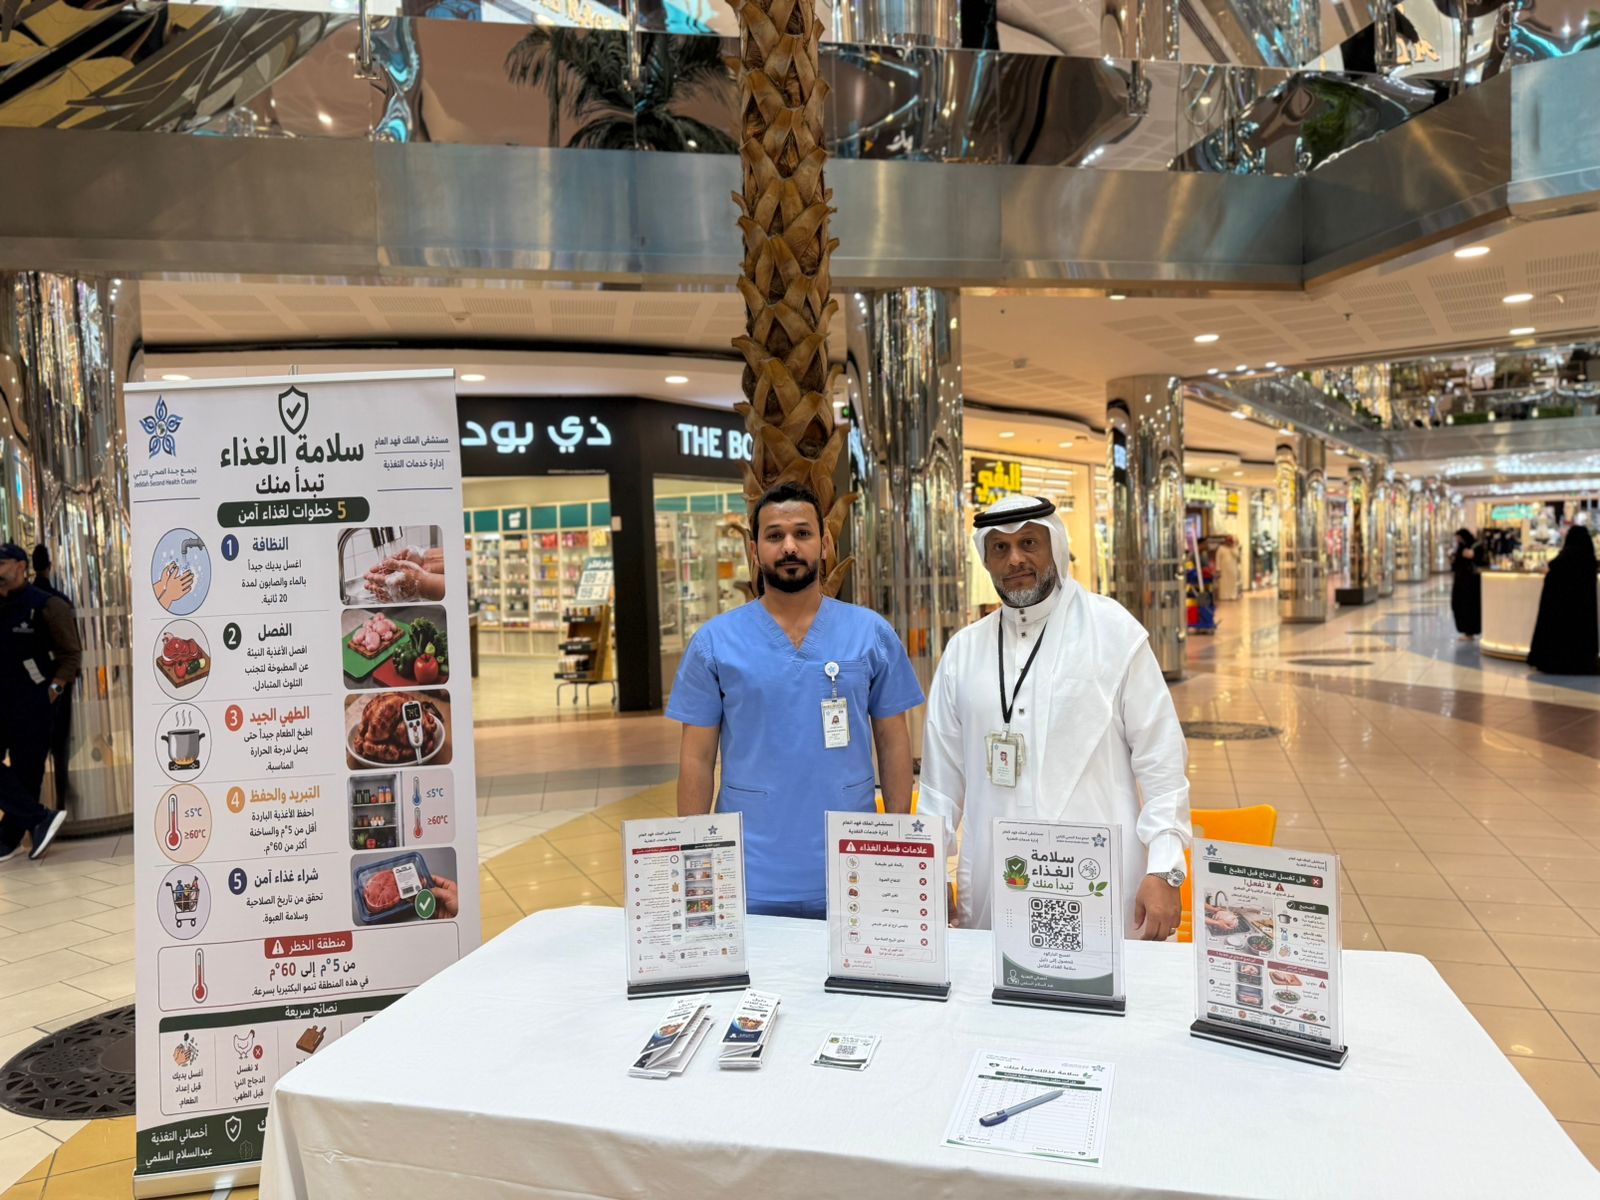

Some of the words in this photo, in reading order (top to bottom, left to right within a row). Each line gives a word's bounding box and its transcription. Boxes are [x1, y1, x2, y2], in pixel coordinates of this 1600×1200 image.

[389, 435, 401, 447] فهد
[402, 435, 420, 445] الملك
[420, 435, 449, 447] مستشفى
[547, 416, 612, 454] ذي
[677, 422, 723, 459] THE
[295, 432, 364, 463] سلامة
[374, 436, 389, 449] العام
[220, 435, 287, 468] الغذاء
[383, 459, 405, 472] التغذية
[406, 459, 428, 469] خدمات
[429, 459, 445, 471] إدارة
[256, 474, 291, 495] منك
[294, 466, 324, 499] تبدأ
[238, 503, 259, 525] آمن
[262, 504, 289, 520] لغذاء
[292, 503, 333, 522] خطوات
[337, 501, 347, 520] 5
[227, 539, 233, 558] 1
[252, 536, 289, 552] النظافة
[265, 561, 282, 572] يديك
[241, 578, 258, 588] لمدة
[259, 577, 288, 590] والصابون
[289, 576, 307, 588] بالماء
[279, 593, 288, 603] 20
[228, 627, 238, 646] 2
[258, 622, 292, 642] الفصل
[267, 645, 288, 659] الأغذية
[244, 664, 266, 677] لتجنب
[267, 662, 298, 674] المطبوخة
[299, 663, 310, 673] عن
[282, 678, 303, 690] التلوث
[229, 709, 239, 727] 3
[249, 707, 277, 726] الجيد
[279, 705, 310, 728] الطهي
[243, 731, 258, 743] حتى
[275, 728, 296, 742] الطعام
[250, 746, 273, 758] الحرارة
[273, 745, 292, 756] لدرجة
[293, 744, 309, 756] يصل
[230, 791, 241, 808] 4
[249, 787, 288, 805] والحفظ
[288, 785, 321, 804] التبريد
[251, 811, 273, 823] الباردة
[273, 809, 296, 822] الأغذية
[249, 826, 280, 838] والساخنة
[294, 826, 304, 837] من
[305, 821, 317, 836] أقل
[284, 844, 294, 853] من
[295, 838, 308, 852] أكثر
[859, 842, 881, 852] الغذاء
[882, 843, 901, 853] فساد
[901, 844, 928, 854] علامات
[1031, 849, 1074, 864] سلامة
[274, 870, 296, 884] غذاء
[297, 868, 319, 885] شراء
[1031, 864, 1074, 878] الغذاء
[233, 872, 243, 891] 5
[254, 869, 272, 888] آمن
[1032, 879, 1054, 889] منك
[1055, 877, 1074, 893] تبدأ
[246, 896, 276, 909] الصلاحية
[277, 895, 293, 908] تاريخ
[294, 897, 304, 905] من
[305, 892, 324, 905] تحقق
[285, 911, 309, 922] وسلامة
[288, 939, 315, 955] الخطر
[316, 937, 346, 950] منطقة
[300, 962, 316, 979] إلى
[343, 961, 356, 973] من
[303, 983, 317, 994] تنمو
[318, 979, 344, 991] المنطقة
[345, 978, 358, 988] هذه
[360, 976, 369, 990] في
[276, 984, 303, 997] البكتيريا
[285, 1005, 311, 1020] سريعة
[312, 1002, 338, 1020] نصائح
[254, 1063, 259, 1072] لا
[191, 1081, 202, 1093] قبل
[247, 1075, 266, 1088] الدجاج
[253, 1088, 264, 1099] قبل
[151, 1130, 178, 1146] التغذية
[180, 1124, 208, 1145] أخصائي
[145, 1150, 174, 1168] السلمي
